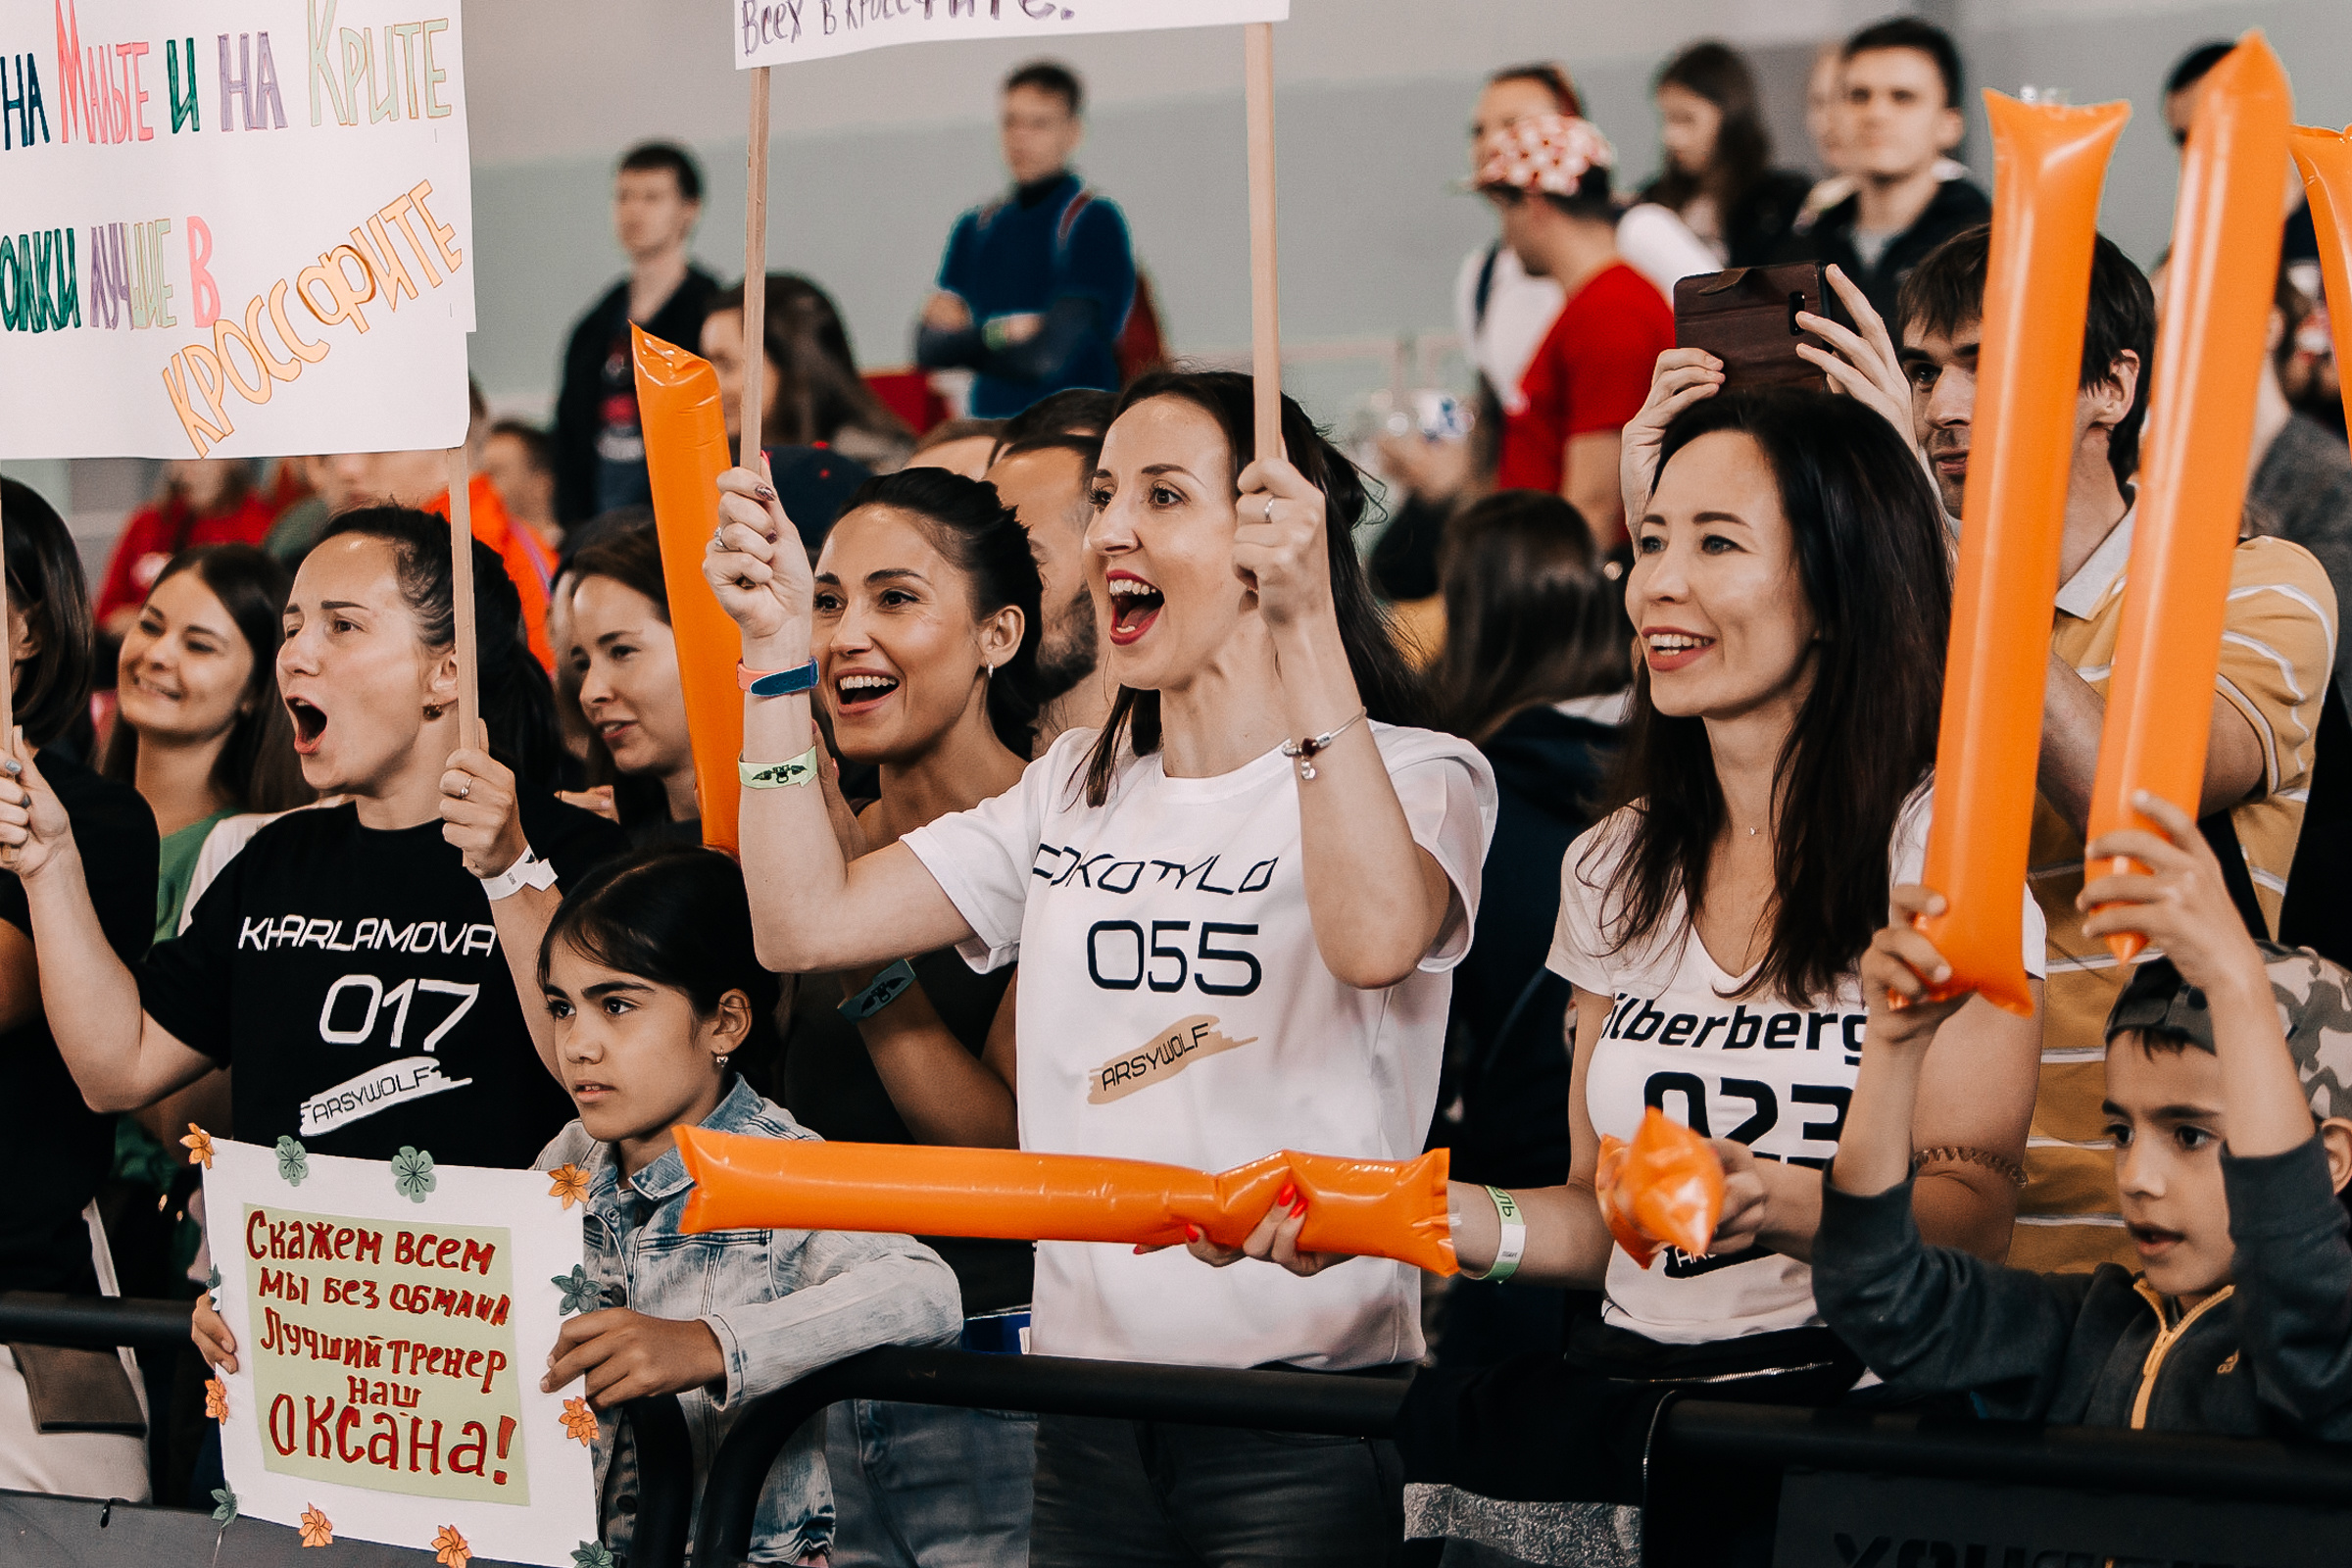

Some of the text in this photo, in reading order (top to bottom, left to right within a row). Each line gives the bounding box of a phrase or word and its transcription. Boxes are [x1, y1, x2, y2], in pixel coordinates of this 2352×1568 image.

[167, 37, 200, 134] И
[218, 31, 288, 131] НА
[187, 216, 221, 328] В
[1087, 919, 1262, 997] 055
[318, 974, 480, 1053] 017
[1101, 1022, 1209, 1091] ARSYWOLF
[313, 1065, 432, 1124] ARSYWOLF
[246, 1209, 384, 1265] Скажем
[260, 1307, 385, 1368] Лучший
